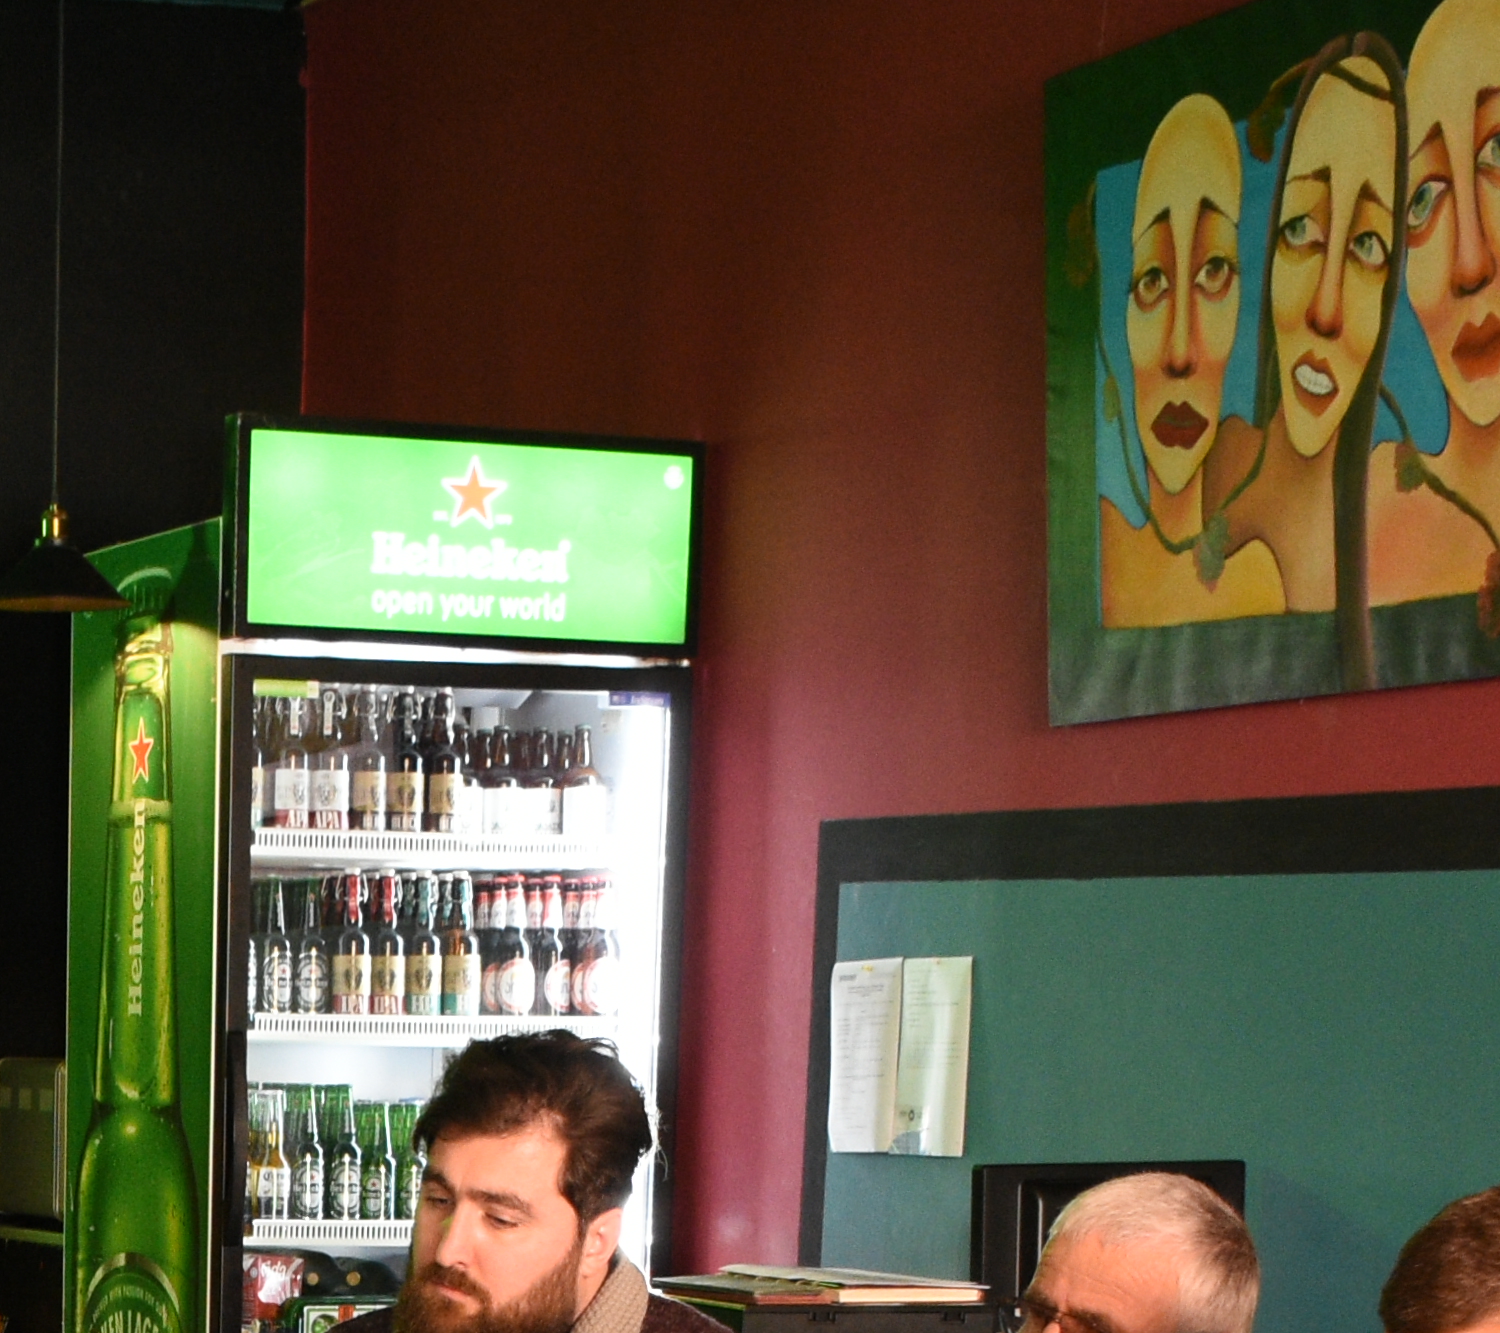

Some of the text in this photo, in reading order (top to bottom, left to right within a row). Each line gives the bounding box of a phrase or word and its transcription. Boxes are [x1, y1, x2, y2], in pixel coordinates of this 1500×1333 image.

[370, 531, 571, 583] Heineken
[371, 589, 567, 622] open your world
[127, 798, 146, 1017] Heineken
